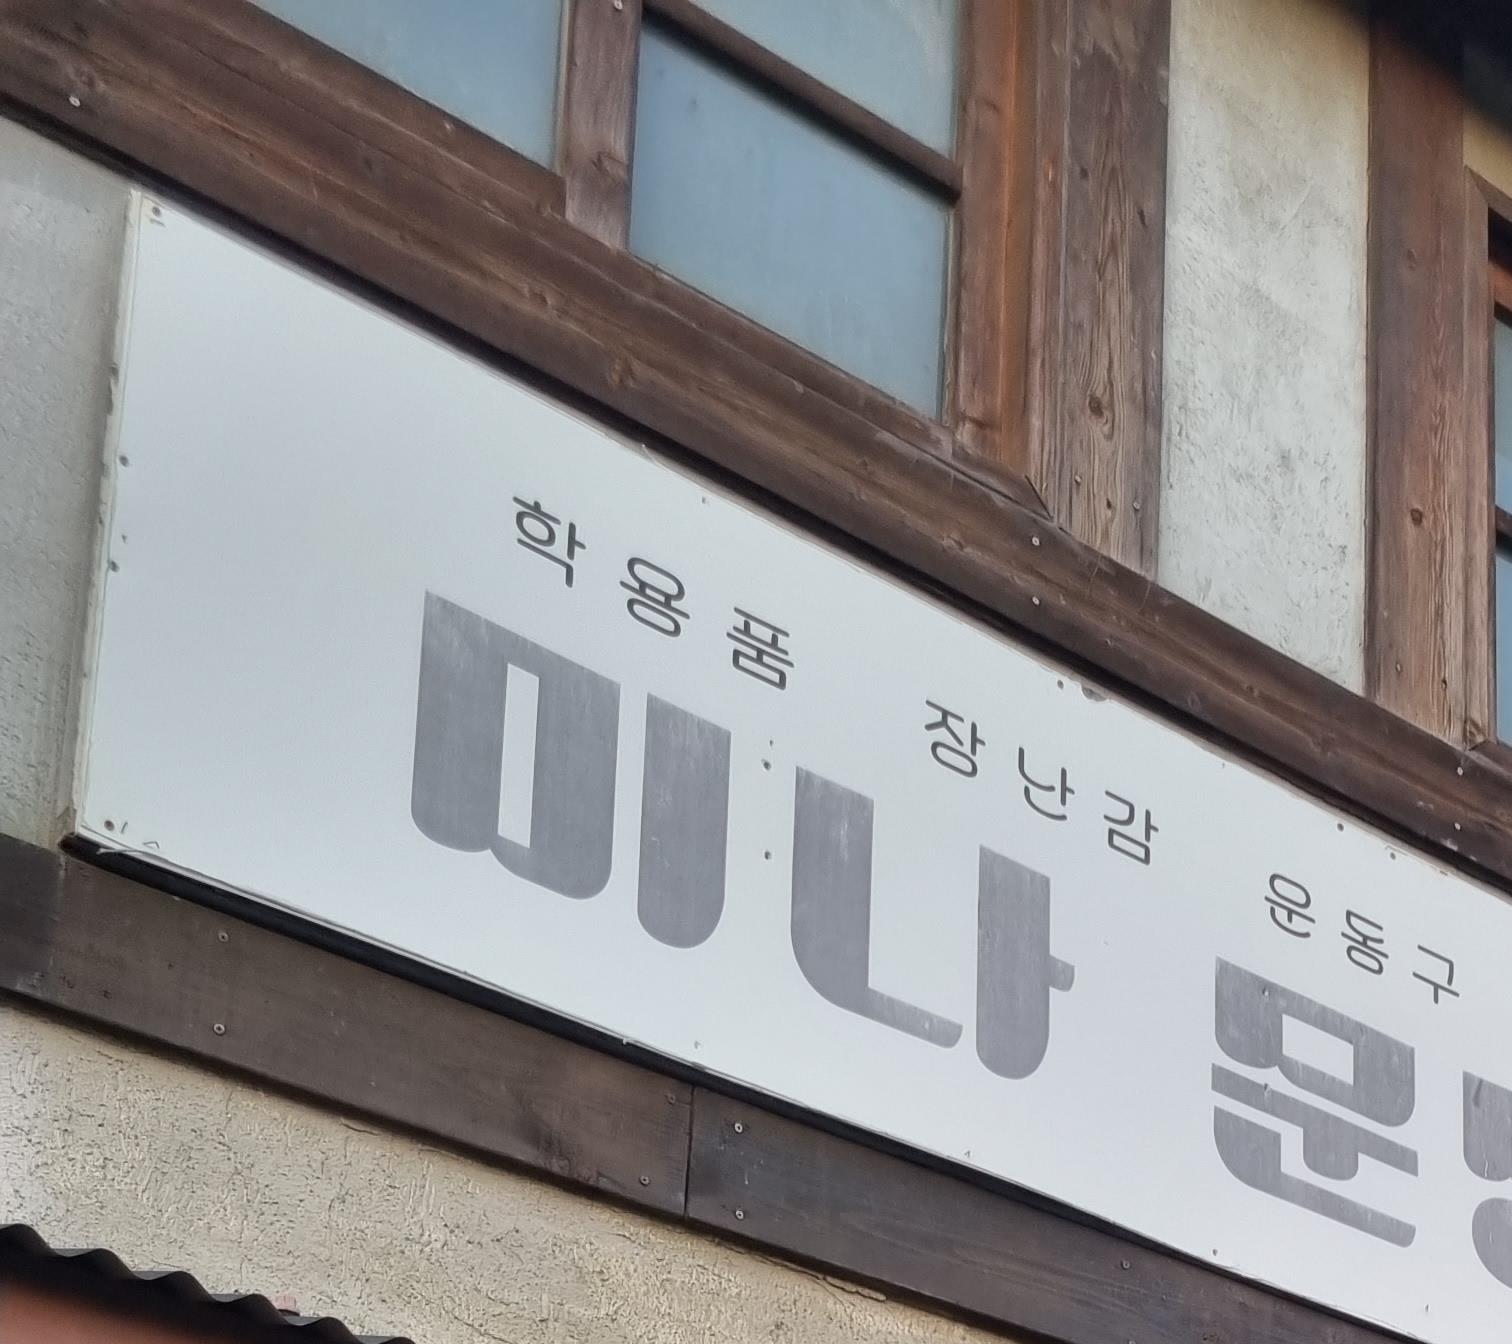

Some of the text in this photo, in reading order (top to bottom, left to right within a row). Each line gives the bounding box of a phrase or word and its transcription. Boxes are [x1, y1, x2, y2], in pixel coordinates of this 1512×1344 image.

[410, 589, 1076, 1082] 미나
[511, 495, 795, 691] 학용품
[924, 699, 1160, 867] 장난감
[1263, 873, 1461, 1006] 운동구
